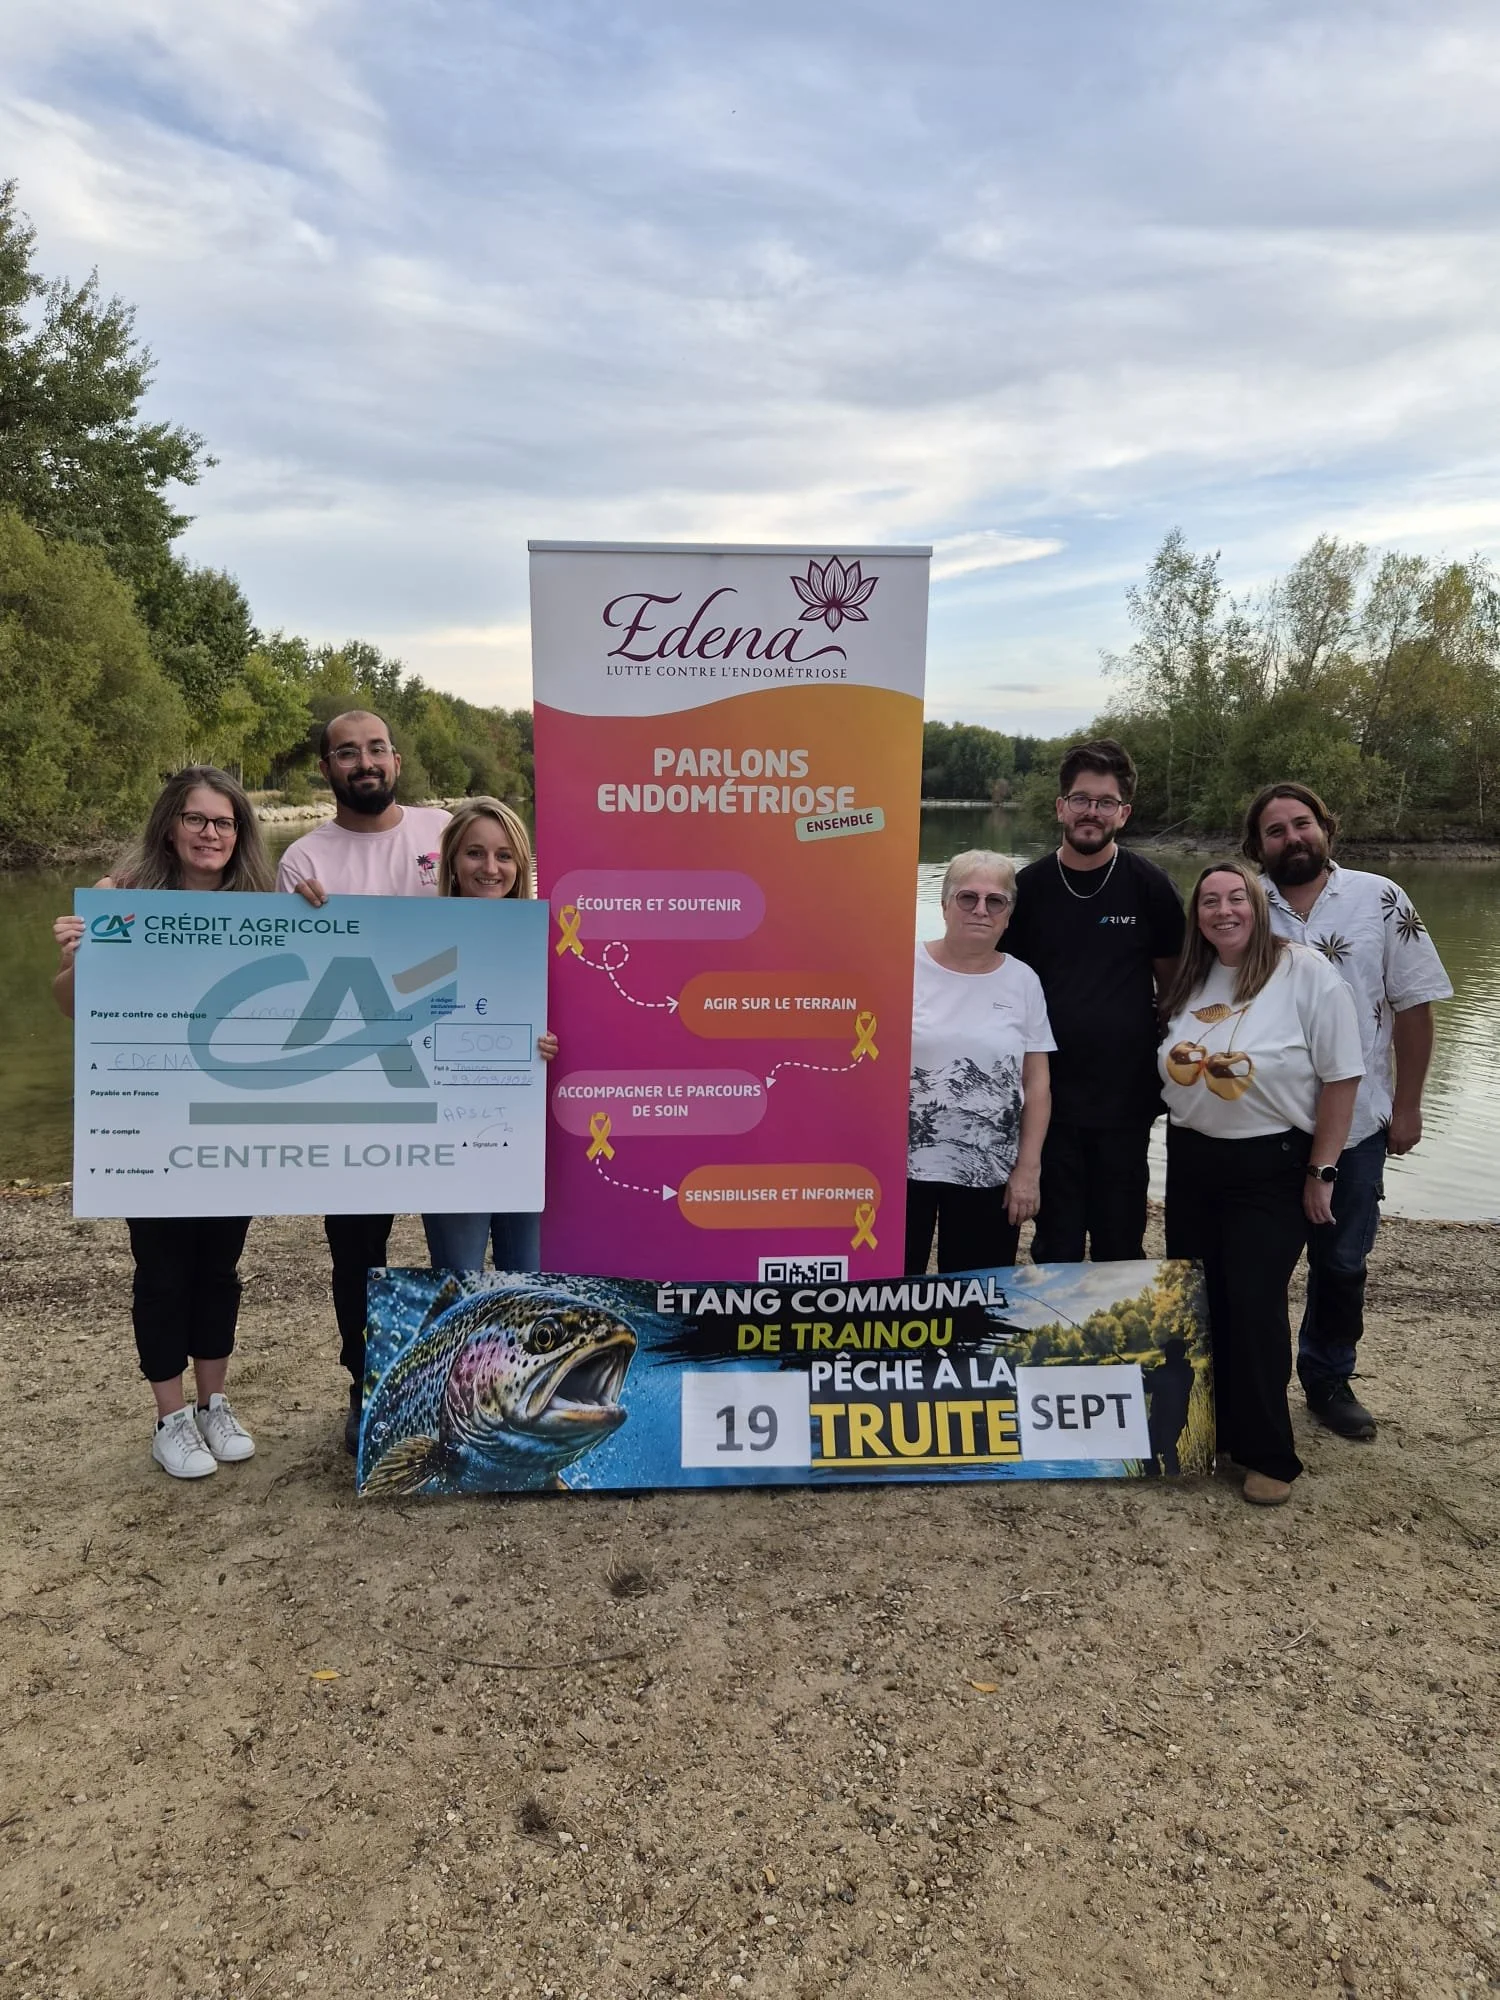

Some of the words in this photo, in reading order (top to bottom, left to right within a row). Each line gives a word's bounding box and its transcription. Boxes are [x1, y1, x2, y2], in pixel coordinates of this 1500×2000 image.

[602, 587, 847, 663] Edena
[606, 665, 652, 677] LUTTE
[656, 666, 717, 678] CONTRE
[721, 665, 848, 679] L'ENDOMÉTRIOSE
[654, 747, 809, 778] PARLONS
[597, 778, 855, 814] ENDOMÉTRIOSE
[806, 812, 874, 834] ENSEMBLE
[576, 894, 642, 912] ÉCOUTER
[646, 898, 664, 911] ET
[668, 898, 742, 912] SOUTENIR
[144, 913, 232, 932] CRÉDIT
[238, 917, 361, 935] AGRICOLE
[144, 932, 223, 945] CENTRE
[229, 934, 287, 947] LOIRE
[703, 997, 737, 1010] AGIR
[741, 997, 772, 1010] SUR
[775, 998, 792, 1010] LE
[795, 997, 857, 1010] TERRAIN
[90, 1010, 120, 1019] Payez
[171, 1010, 207, 1020] chèque
[455, 1031, 514, 1055] 500
[114, 1052, 193, 1069] EDENA
[90, 1089, 120, 1098] Payable
[558, 1085, 664, 1099] ACCOMPAGNER
[667, 1085, 684, 1098] LE
[687, 1084, 762, 1098] PARCOURS
[632, 1105, 652, 1117] DE
[655, 1105, 689, 1117] SOIN
[168, 1144, 331, 1169] CENTRE
[344, 1144, 456, 1168] LOIRE
[685, 1190, 778, 1202] SENSIBILISER
[782, 1188, 799, 1199] ET
[802, 1188, 875, 1200] INFORMER
[656, 1283, 781, 1315] ÉTANG
[790, 1275, 1005, 1314] COMMUNAL
[737, 1322, 781, 1351] DE
[795, 1317, 953, 1350] TRAINOU
[811, 1353, 924, 1393] PÊCHE
[932, 1348, 960, 1389] À
[969, 1355, 1017, 1388] LA
[1030, 1393, 1133, 1431] SEPT
[713, 1404, 779, 1453] 19
[808, 1399, 1020, 1460] TRUITE
